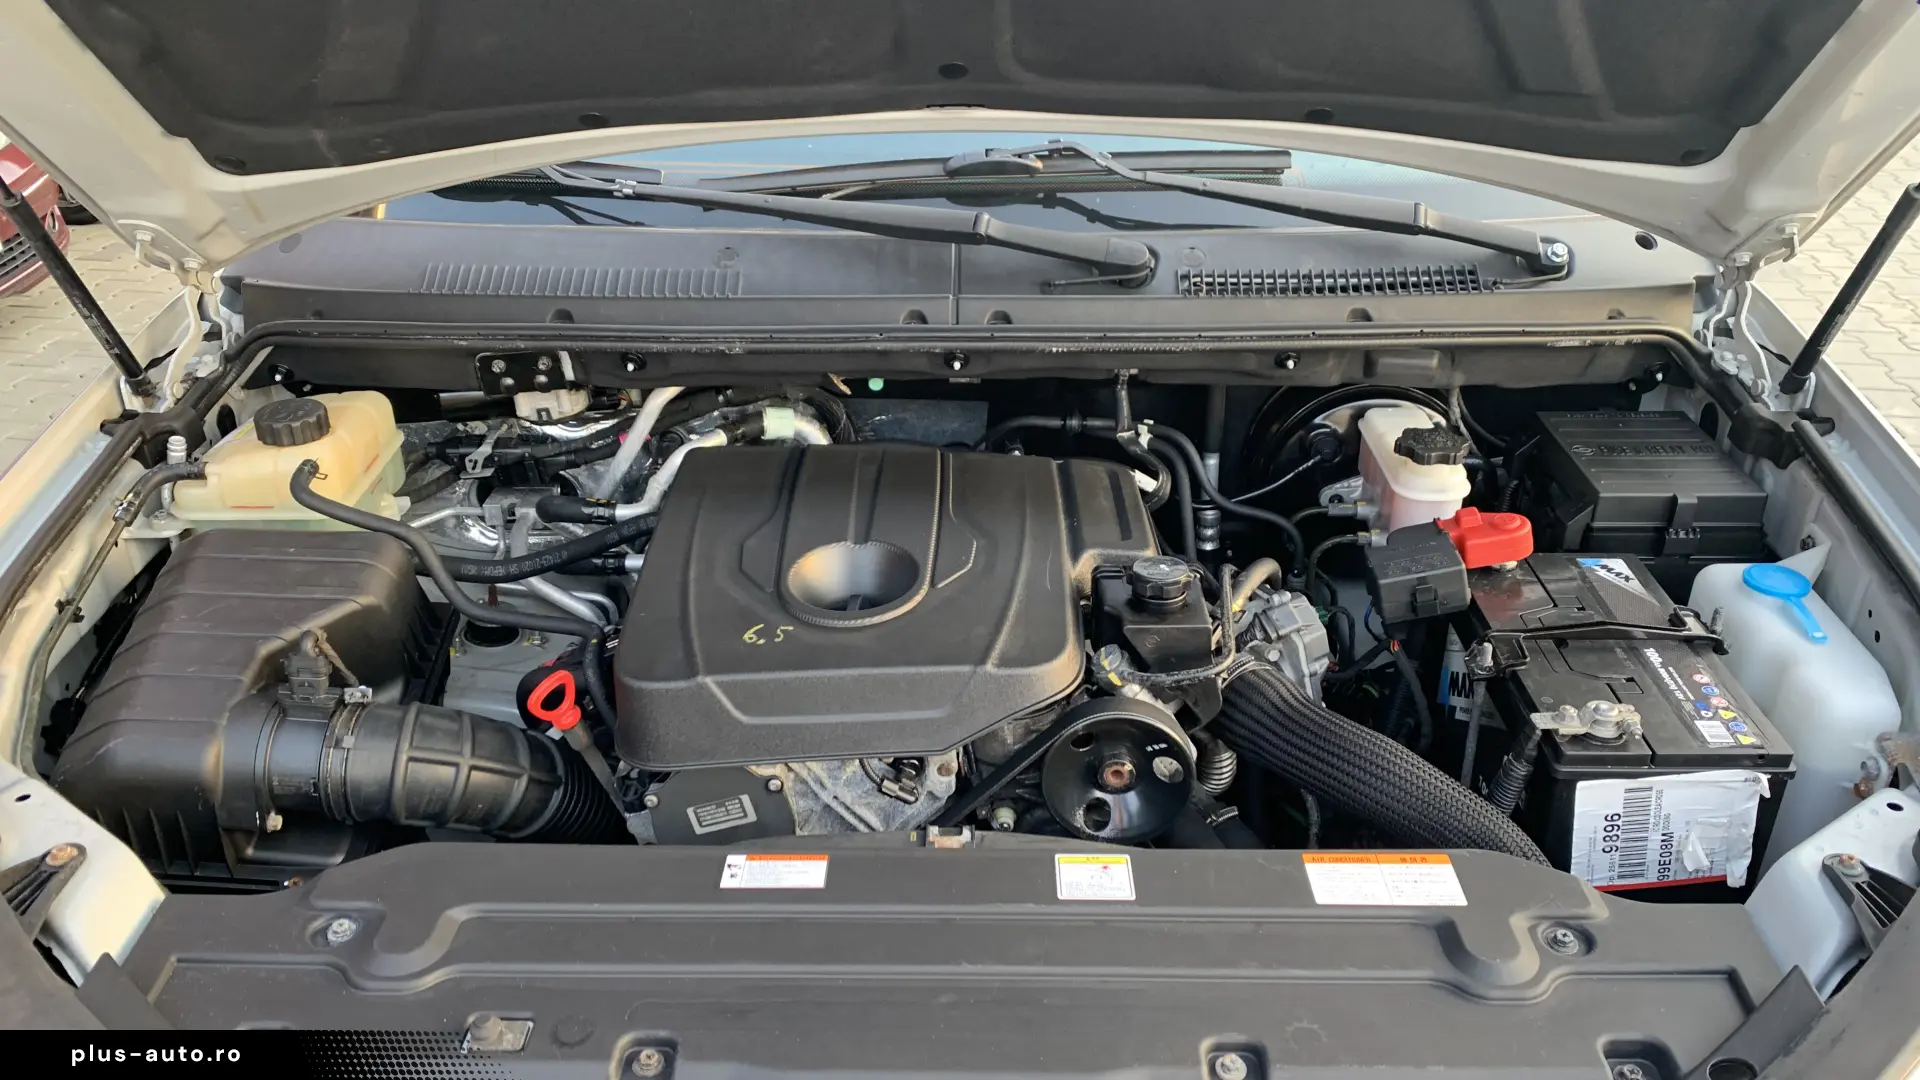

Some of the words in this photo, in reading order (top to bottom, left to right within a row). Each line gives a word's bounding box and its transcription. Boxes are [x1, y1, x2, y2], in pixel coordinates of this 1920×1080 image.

[1594, 563, 1636, 583] MAX
[1601, 812, 1622, 854] 9896
[1656, 831, 1675, 882] 99E08M
